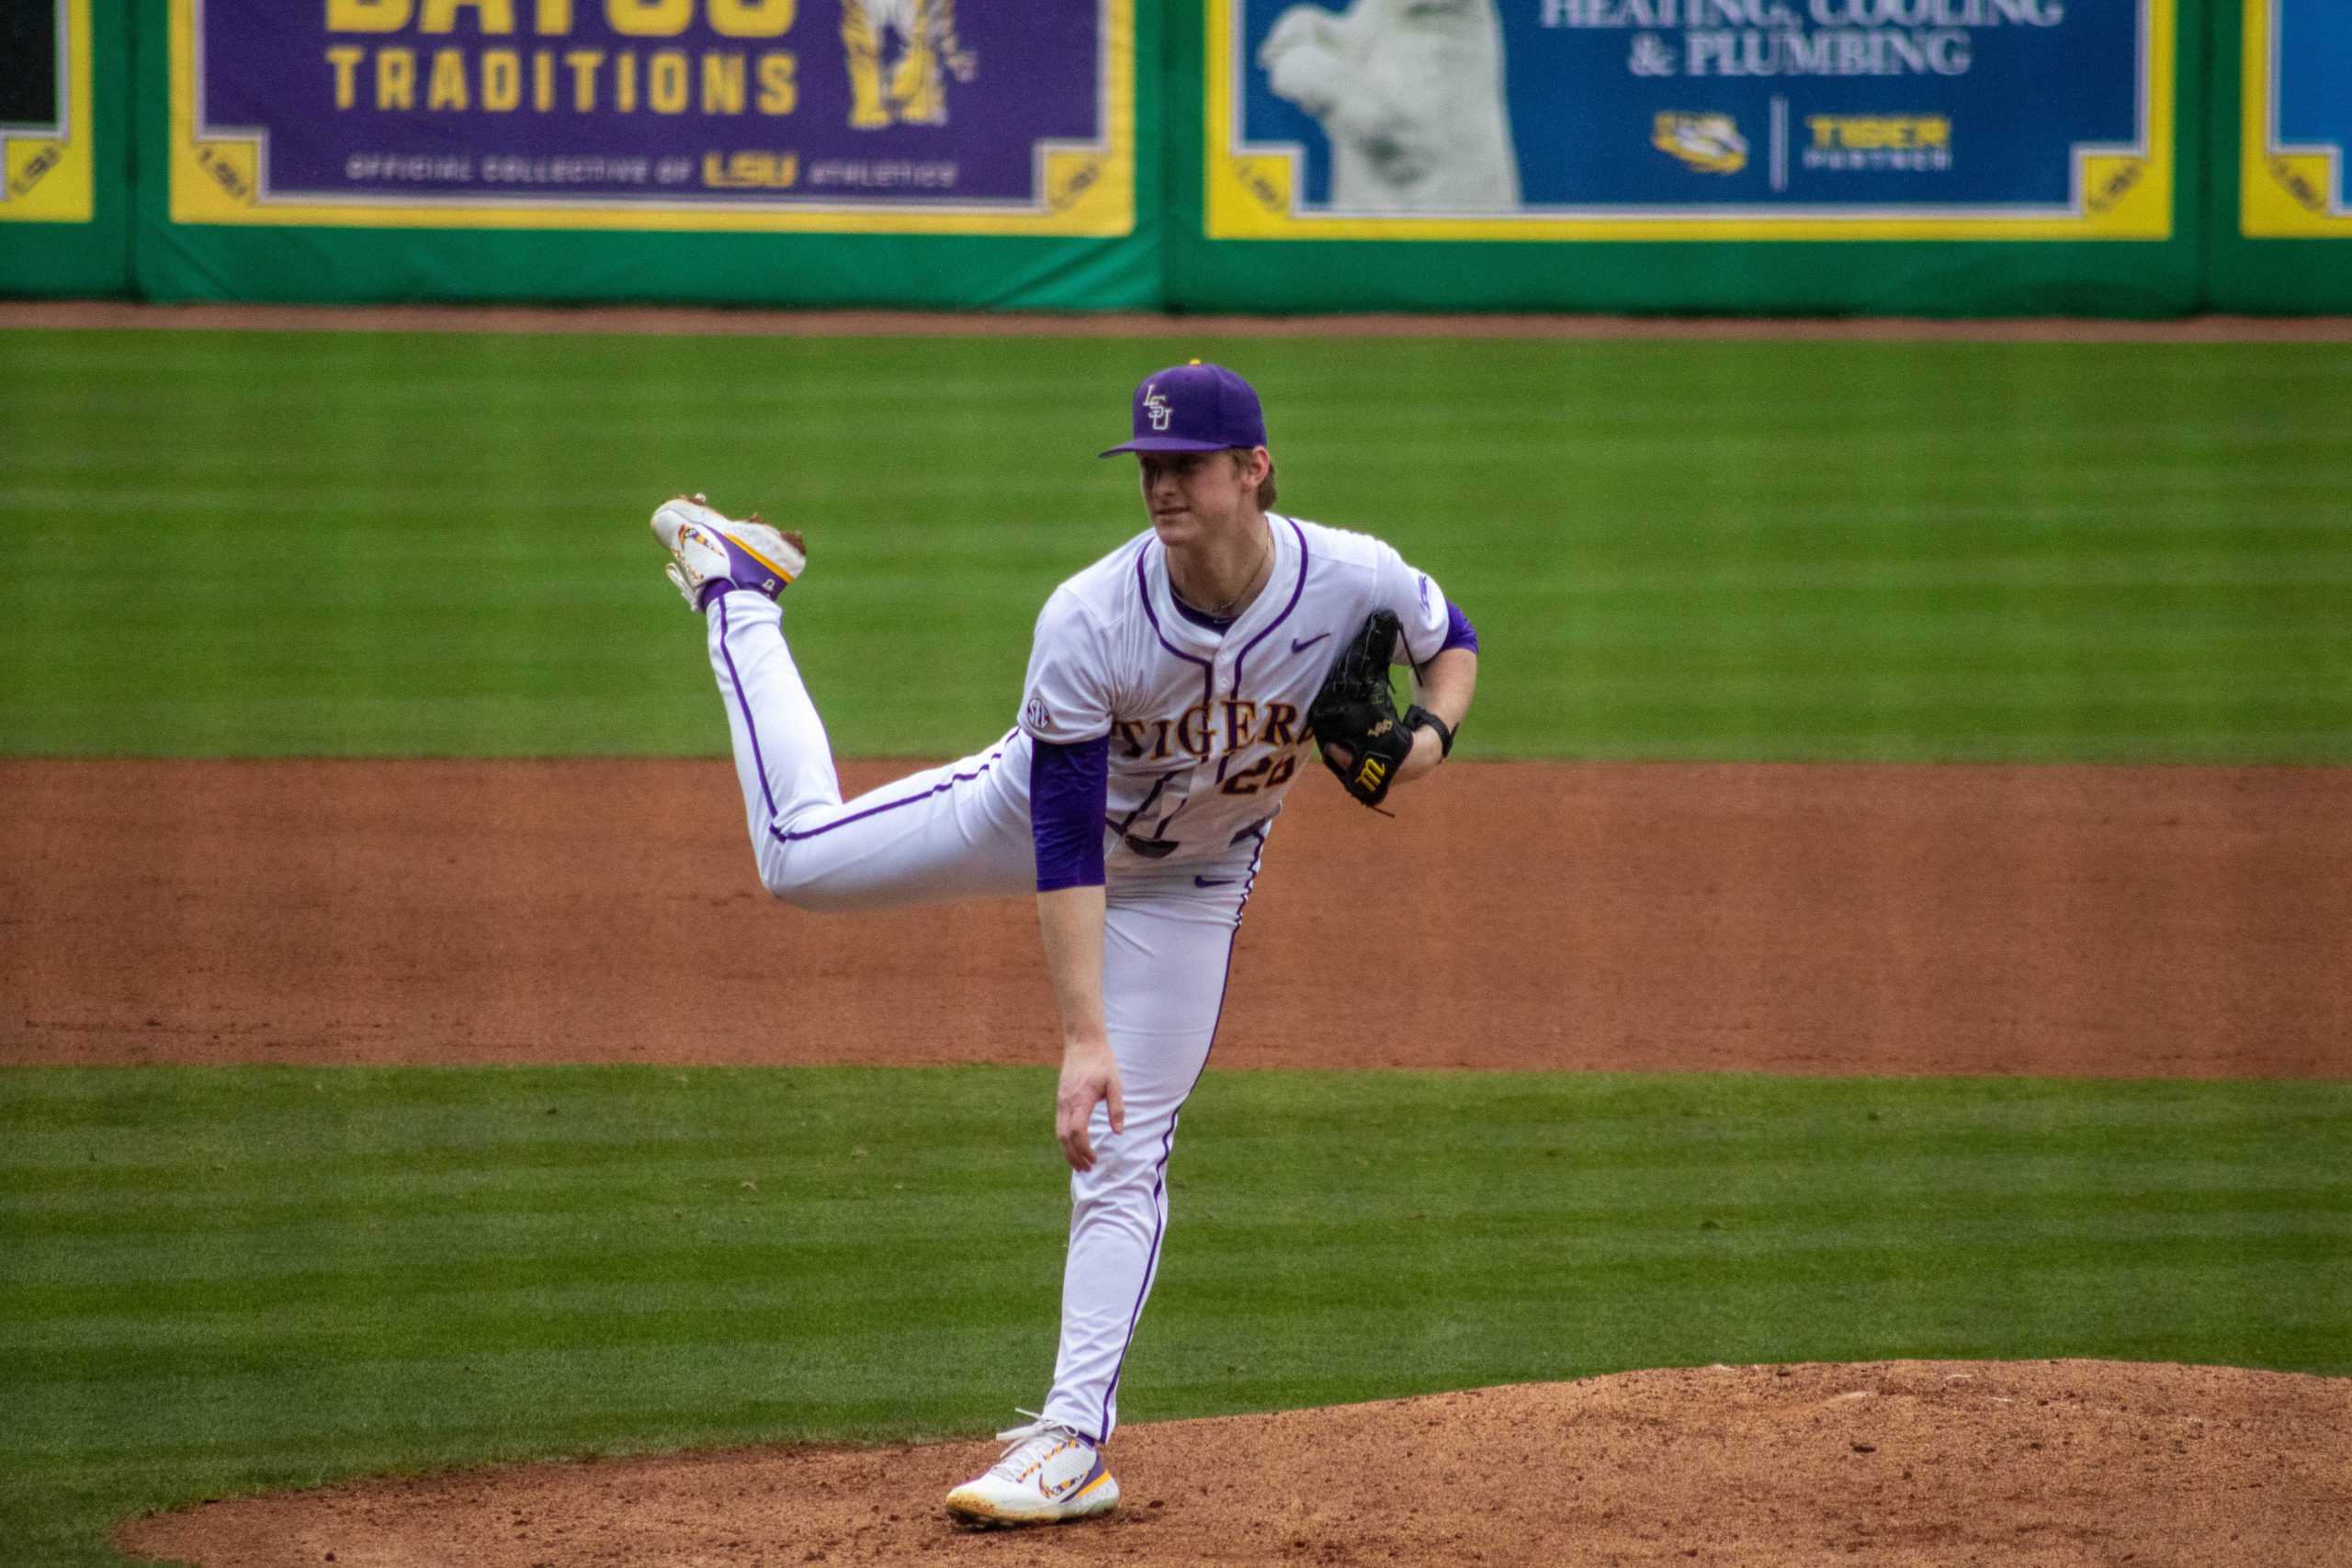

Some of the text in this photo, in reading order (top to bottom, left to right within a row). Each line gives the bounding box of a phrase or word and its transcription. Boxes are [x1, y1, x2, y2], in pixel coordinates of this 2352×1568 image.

[1627, 30, 1973, 76] & PLUMBING
[325, 46, 798, 115] TRADITIONS
[1805, 115, 1951, 148] TIGER
[345, 154, 472, 181] OFFICIAL
[481, 155, 648, 183] COLLECTIVE
[702, 151, 798, 187] LSU
[1143, 384, 1173, 431] LSU
